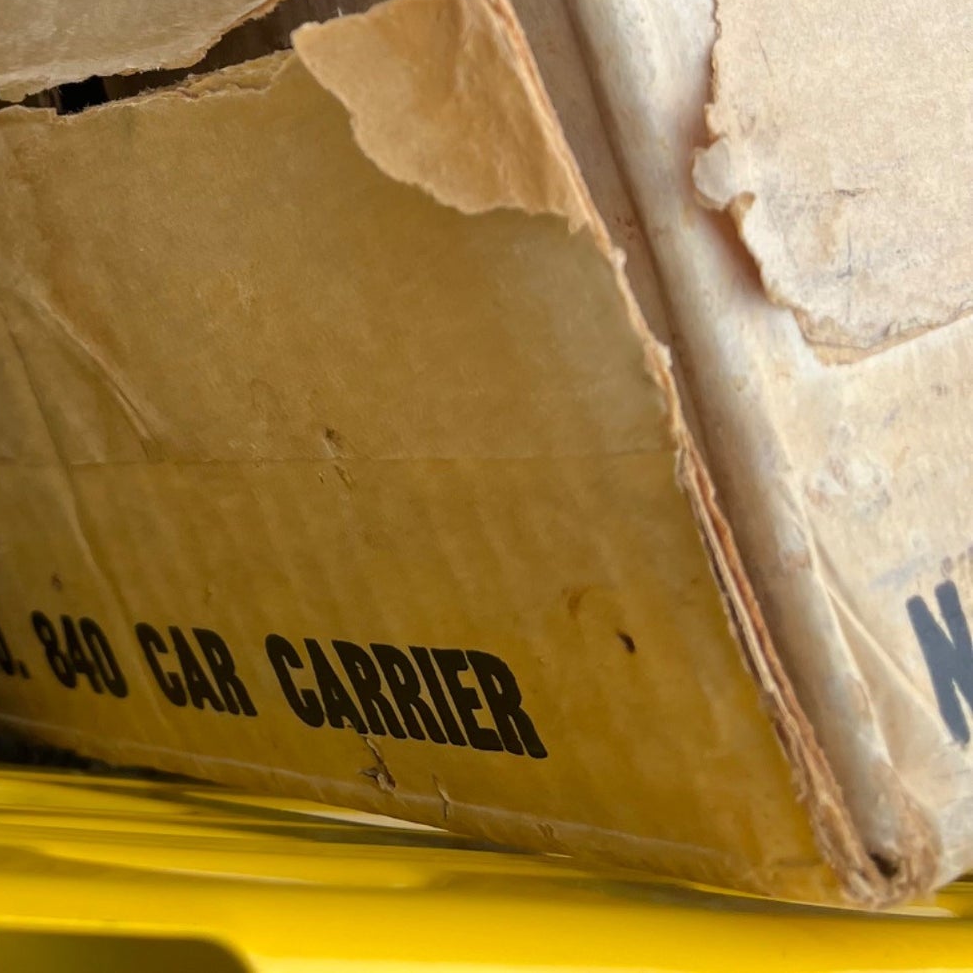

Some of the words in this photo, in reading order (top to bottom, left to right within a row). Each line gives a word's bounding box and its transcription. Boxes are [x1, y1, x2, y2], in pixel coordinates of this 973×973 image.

[31, 610, 129, 698] 840
[134, 622, 258, 717] CAR
[265, 633, 548, 759] CARRIER
